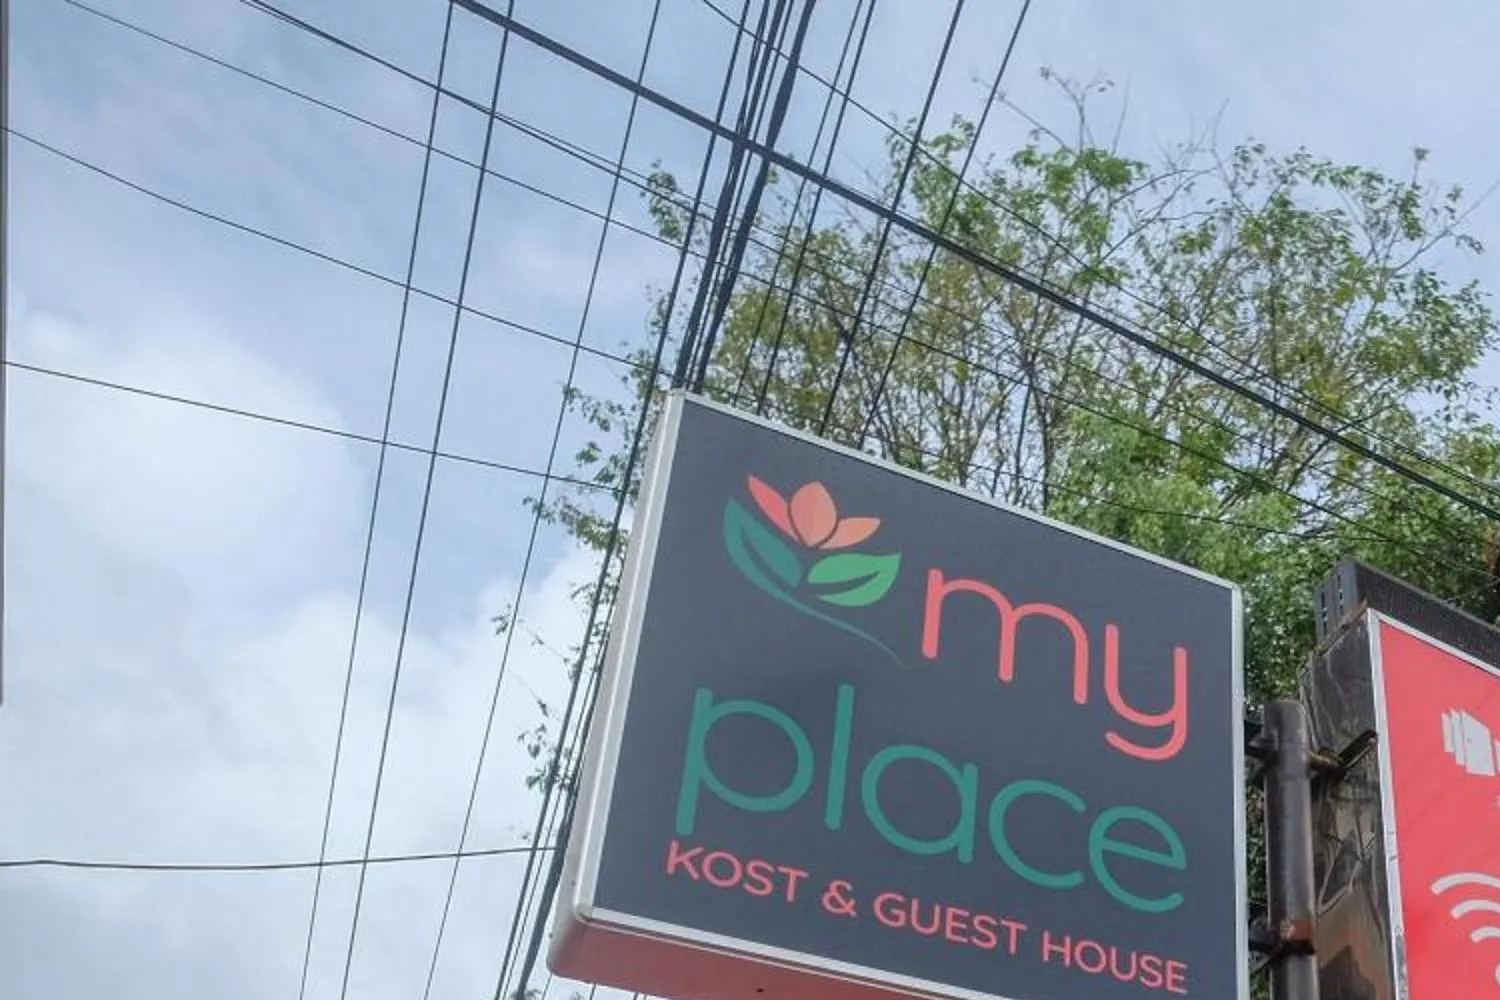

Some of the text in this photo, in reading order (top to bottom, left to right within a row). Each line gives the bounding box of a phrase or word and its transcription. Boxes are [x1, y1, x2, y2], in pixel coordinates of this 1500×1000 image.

[922, 568, 1188, 761] my
[674, 683, 1187, 913] place
[665, 840, 1189, 994] KOST & GUEST HOUSE
